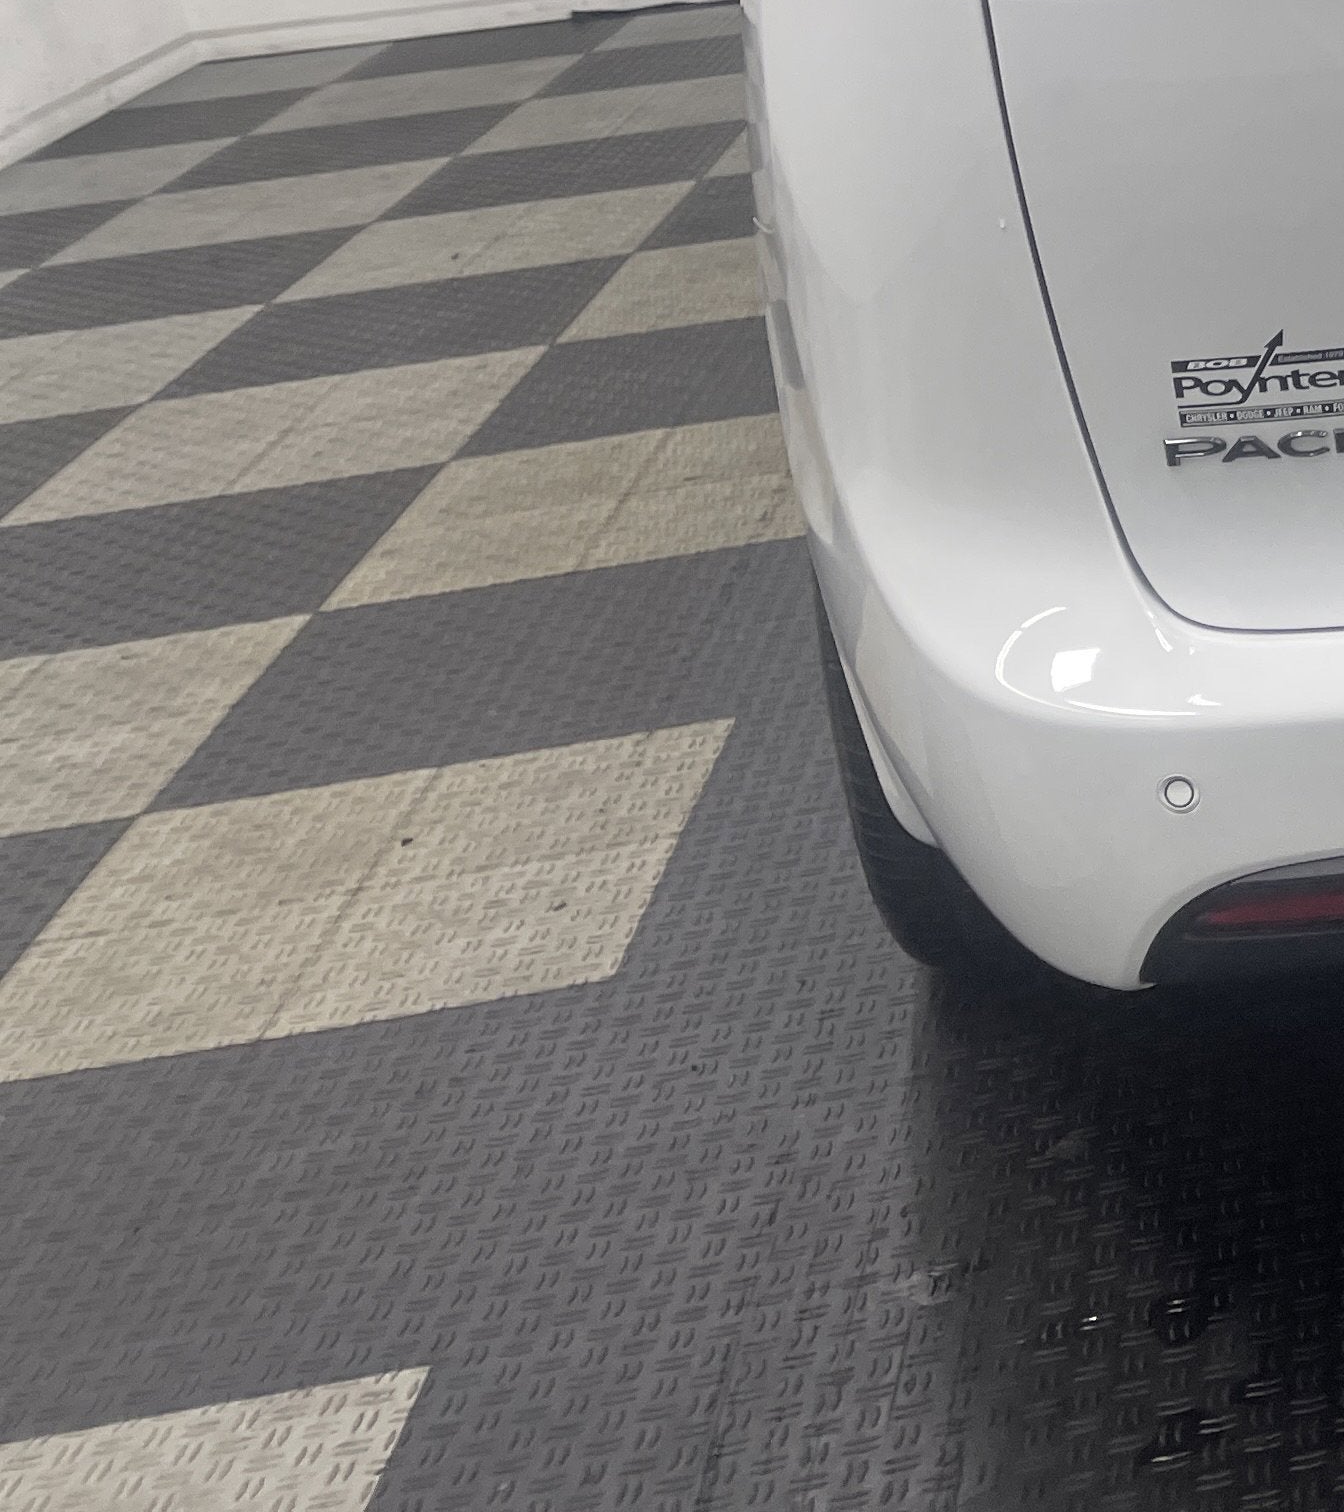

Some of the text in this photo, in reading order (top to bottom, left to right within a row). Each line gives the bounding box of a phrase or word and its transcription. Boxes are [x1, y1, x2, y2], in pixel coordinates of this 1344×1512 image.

[1185, 410, 1228, 423] CHRYSLER
[1236, 408, 1264, 421] DODGE
[1303, 403, 1323, 415] RAM
